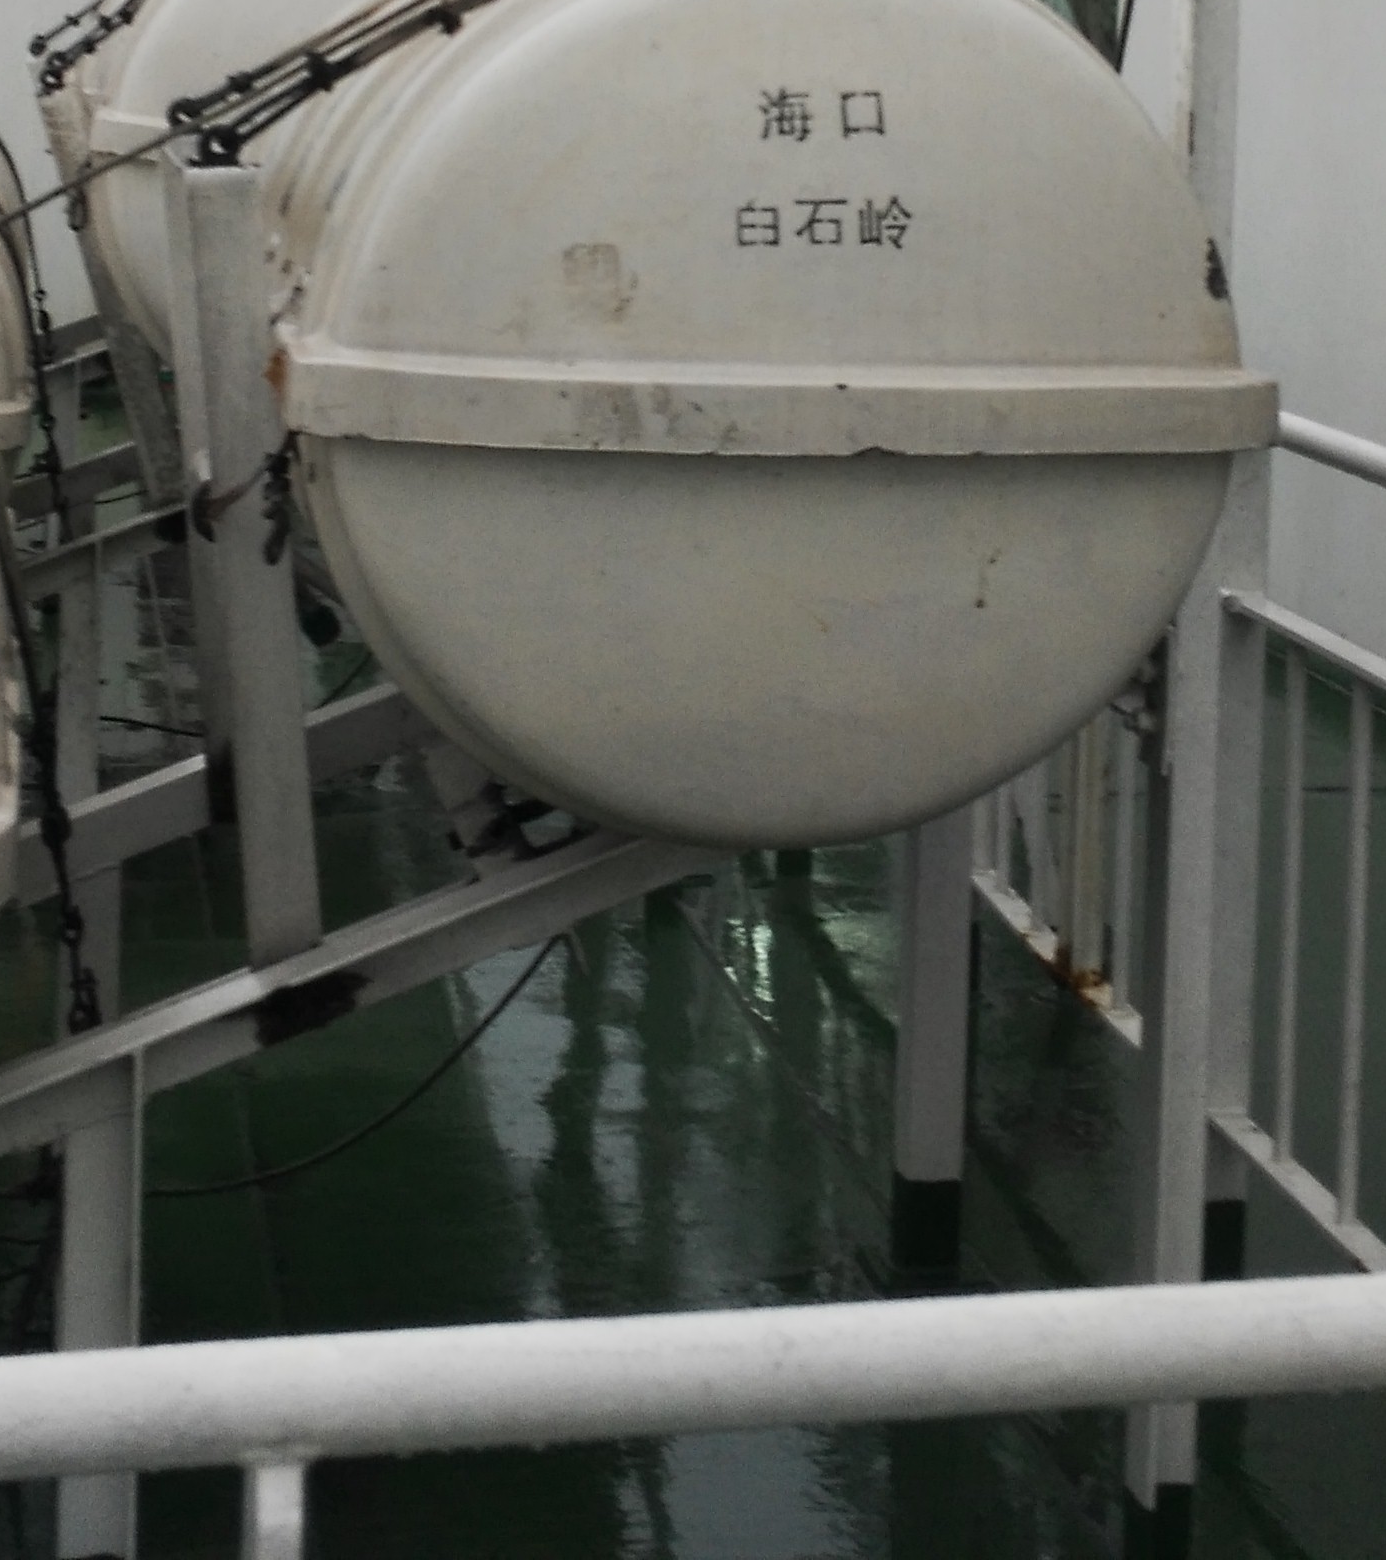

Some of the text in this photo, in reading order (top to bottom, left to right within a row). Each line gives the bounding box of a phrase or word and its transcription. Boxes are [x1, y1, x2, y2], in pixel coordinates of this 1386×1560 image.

[758, 88, 885, 142] 海口
[736, 195, 912, 249] 白石岭
